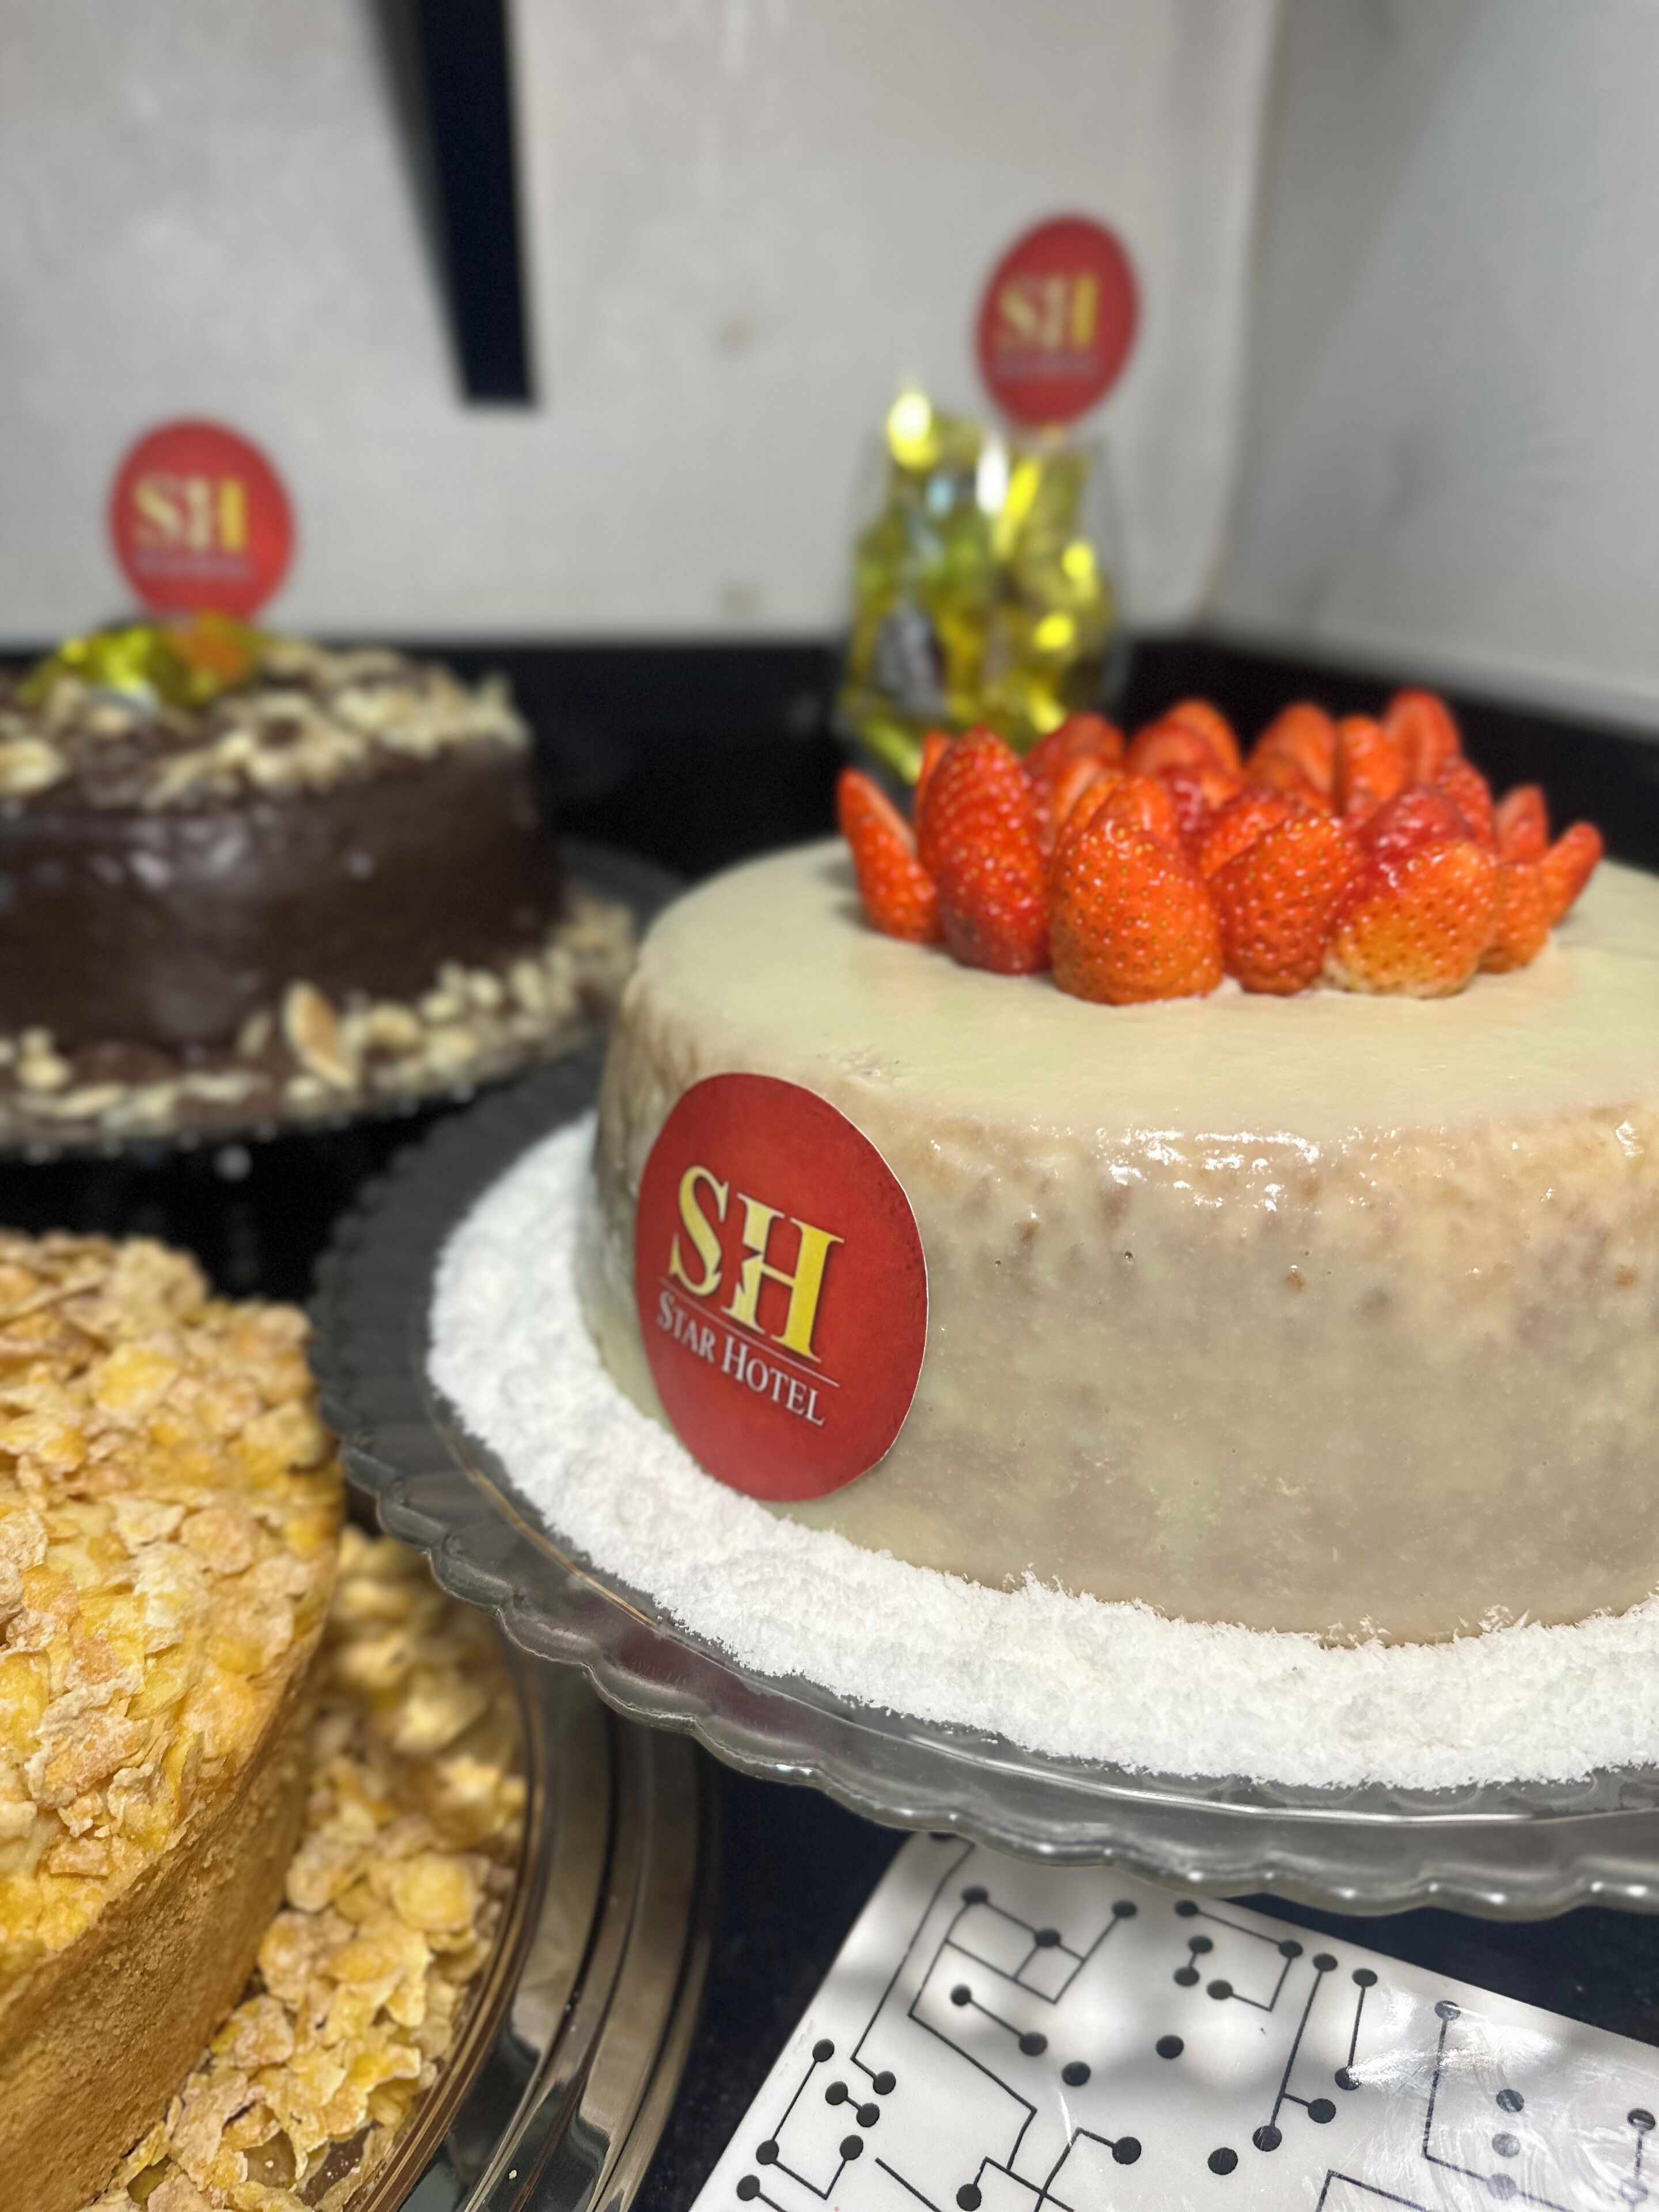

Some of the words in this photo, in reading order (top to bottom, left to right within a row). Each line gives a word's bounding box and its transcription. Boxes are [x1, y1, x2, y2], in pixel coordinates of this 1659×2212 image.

[669, 1165, 845, 1363] SH
[656, 1291, 714, 1365] STAR
[721, 1335, 826, 1427] HOTEL
